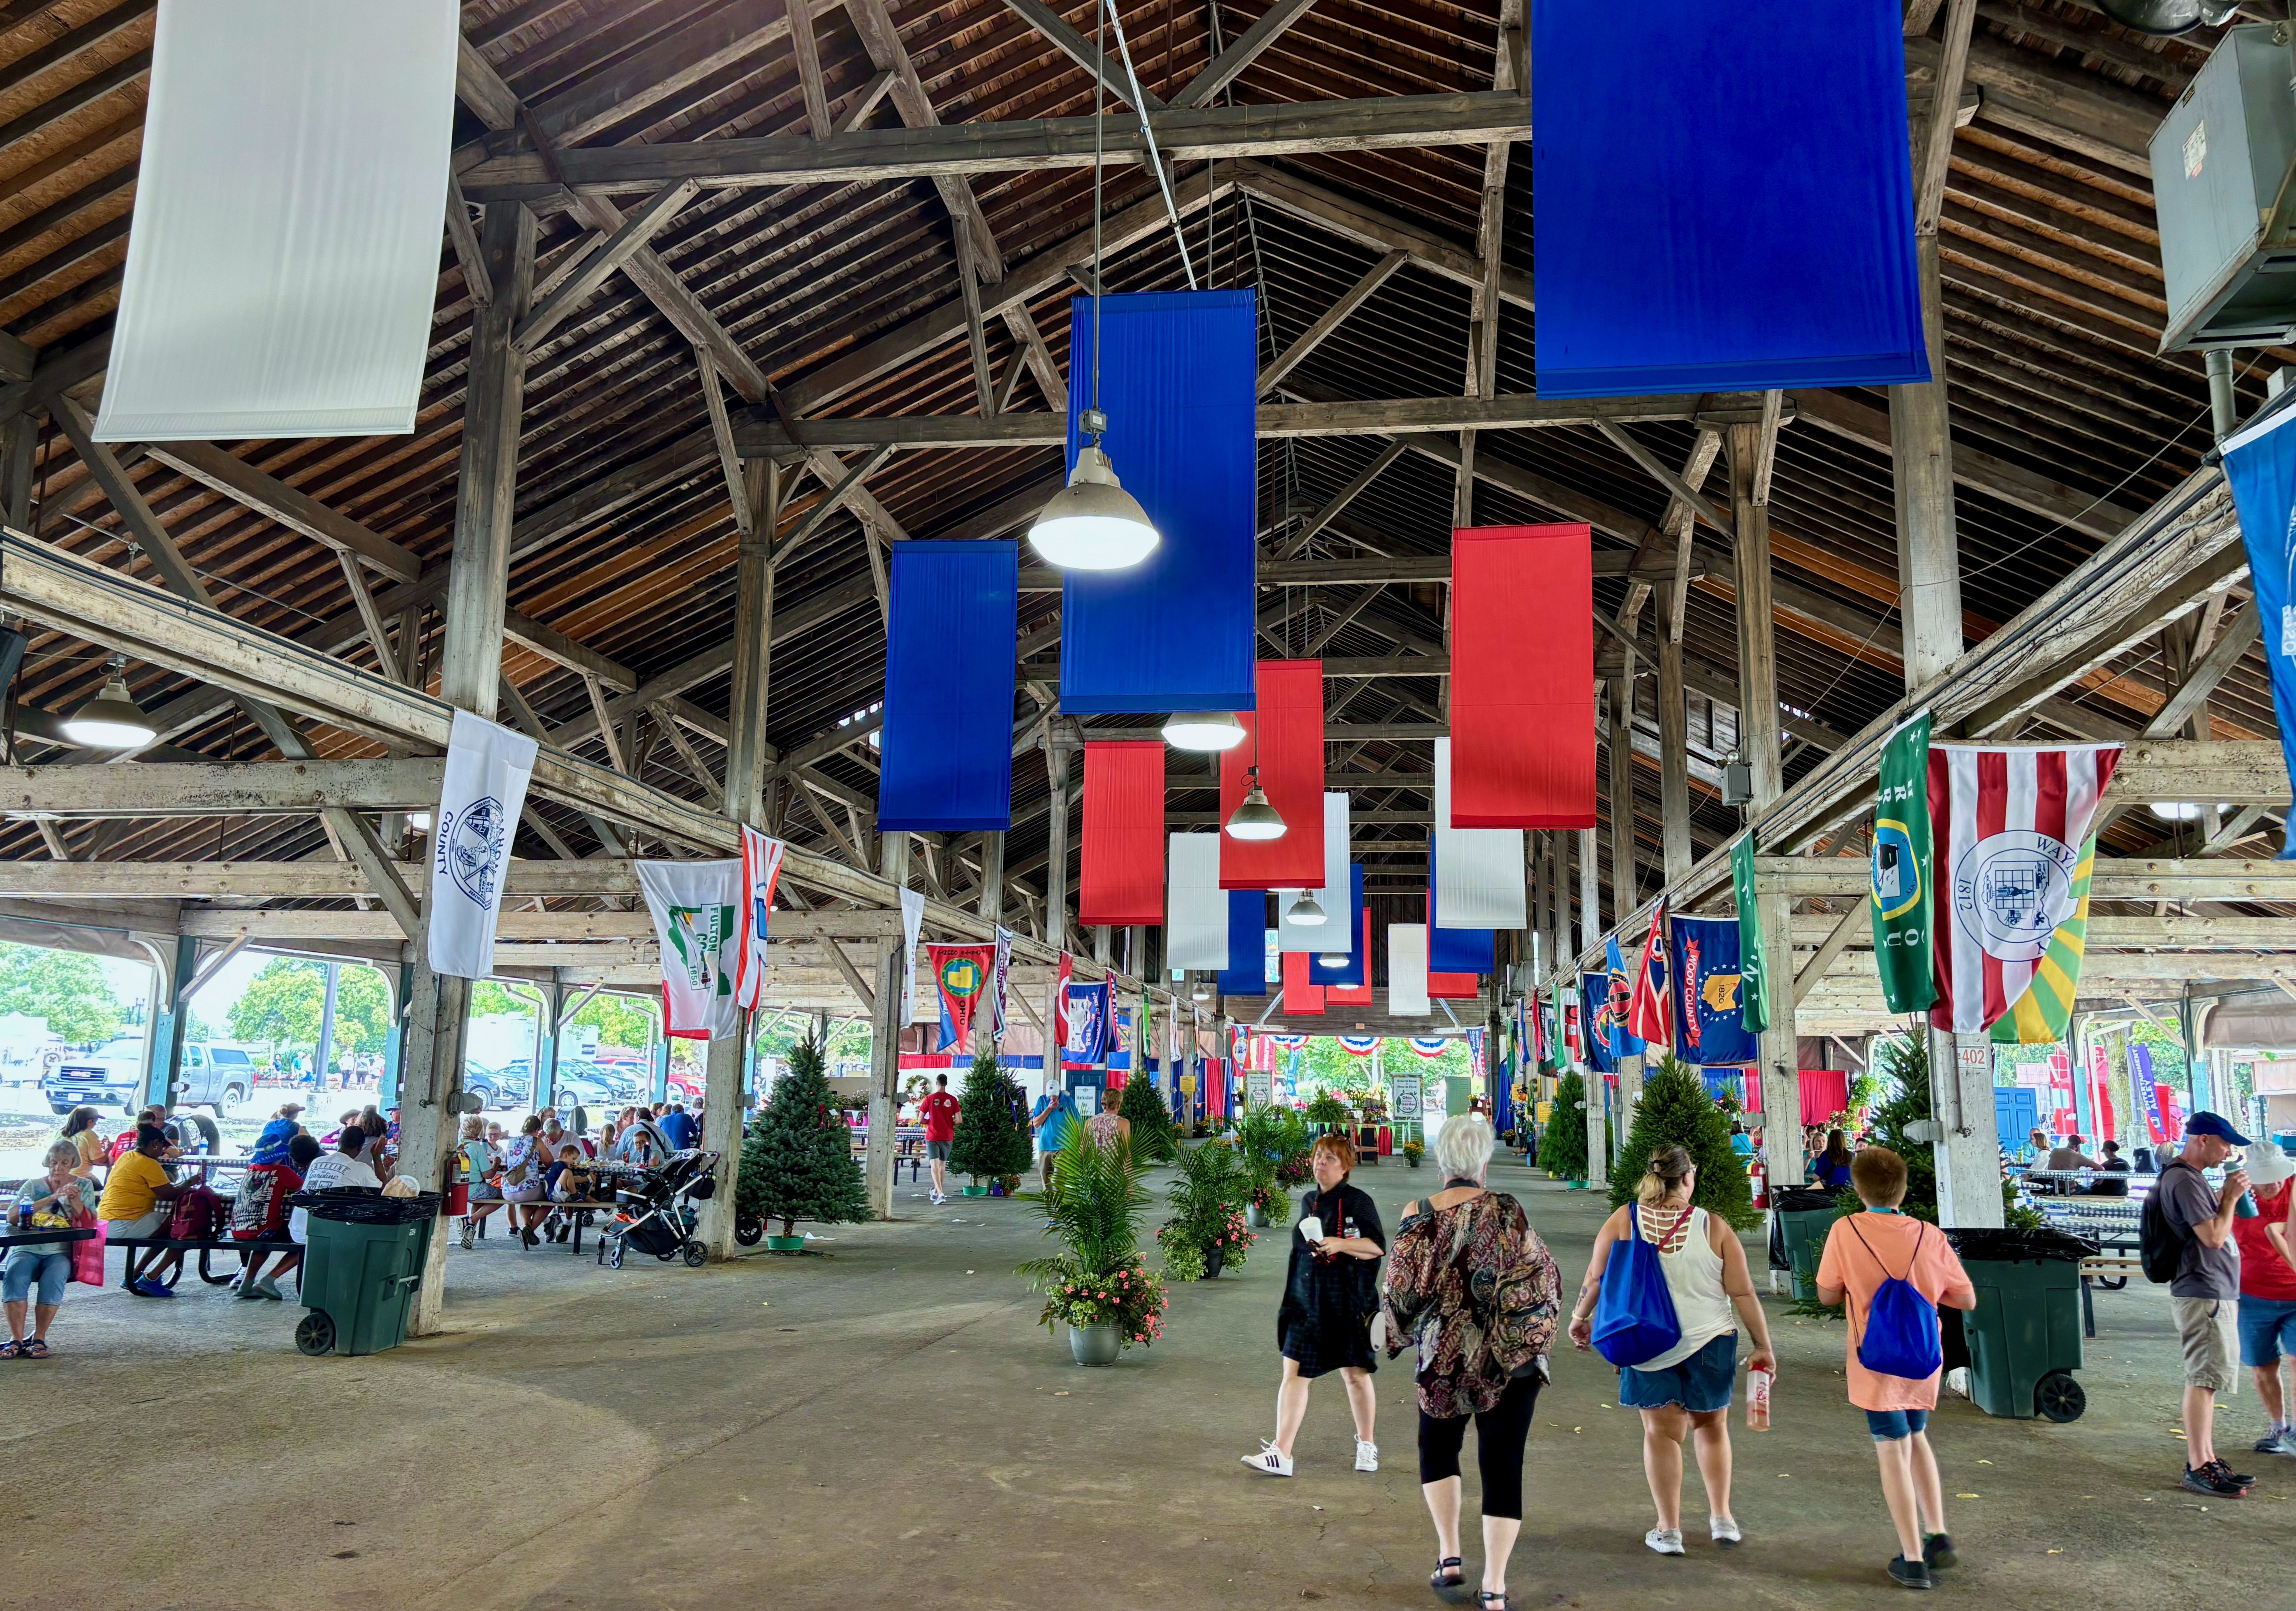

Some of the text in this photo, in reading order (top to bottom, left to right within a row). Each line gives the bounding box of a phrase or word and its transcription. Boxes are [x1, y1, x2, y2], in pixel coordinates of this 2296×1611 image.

[437, 811, 454, 875] COUNTY
[1958, 877, 1972, 911] 1812
[707, 906, 719, 952] FULTON
[689, 964, 698, 986] 1850
[1685, 954, 1699, 1032] WOOD COUNTY
[1095, 1007, 1100, 1016] OF
[1962, 1049, 1985, 1064] 402
[2132, 1048, 2151, 1110] ENTERTAINMENT
[2144, 1080, 2158, 1110] ALLEY
